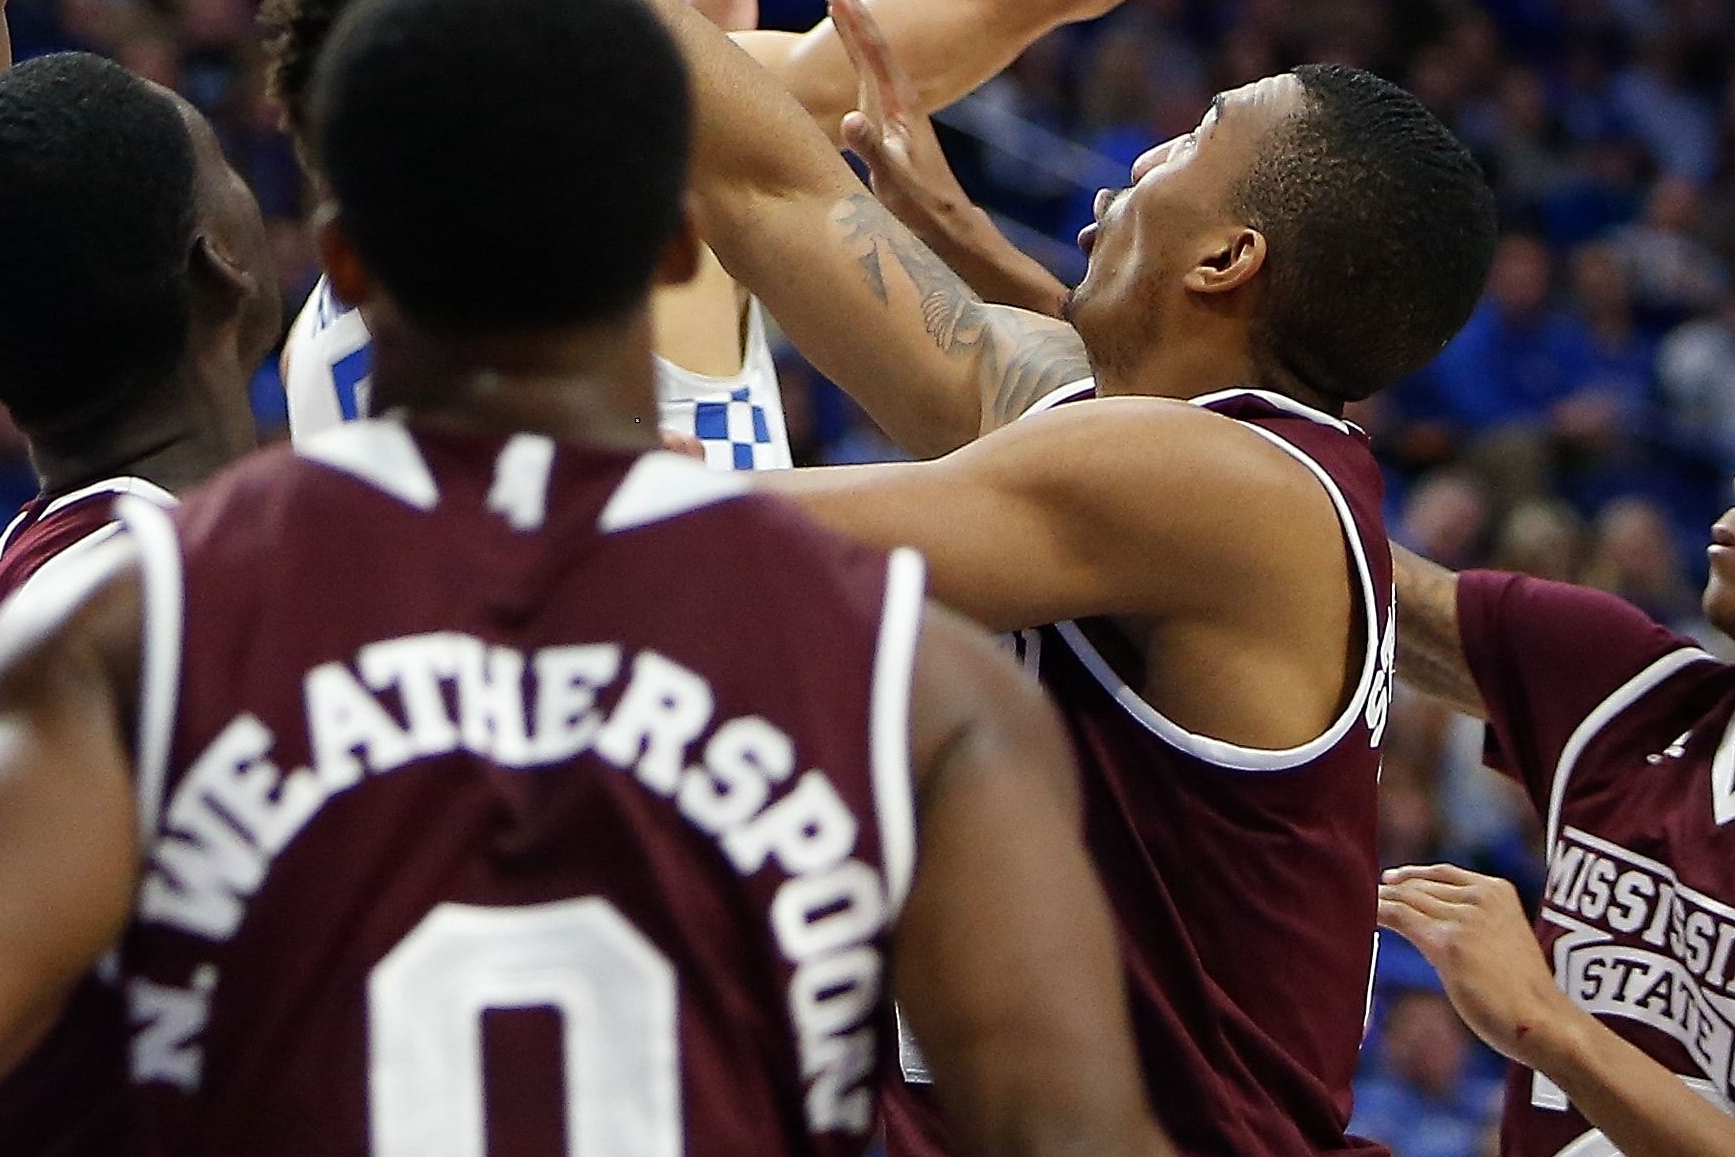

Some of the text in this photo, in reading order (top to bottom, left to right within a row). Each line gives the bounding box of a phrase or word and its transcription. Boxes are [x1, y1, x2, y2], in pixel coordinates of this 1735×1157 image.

[138, 631, 885, 1136] WEATHERSPOON
[1544, 840, 1735, 994] MISSISSI
[367, 896, 686, 1157] 0
